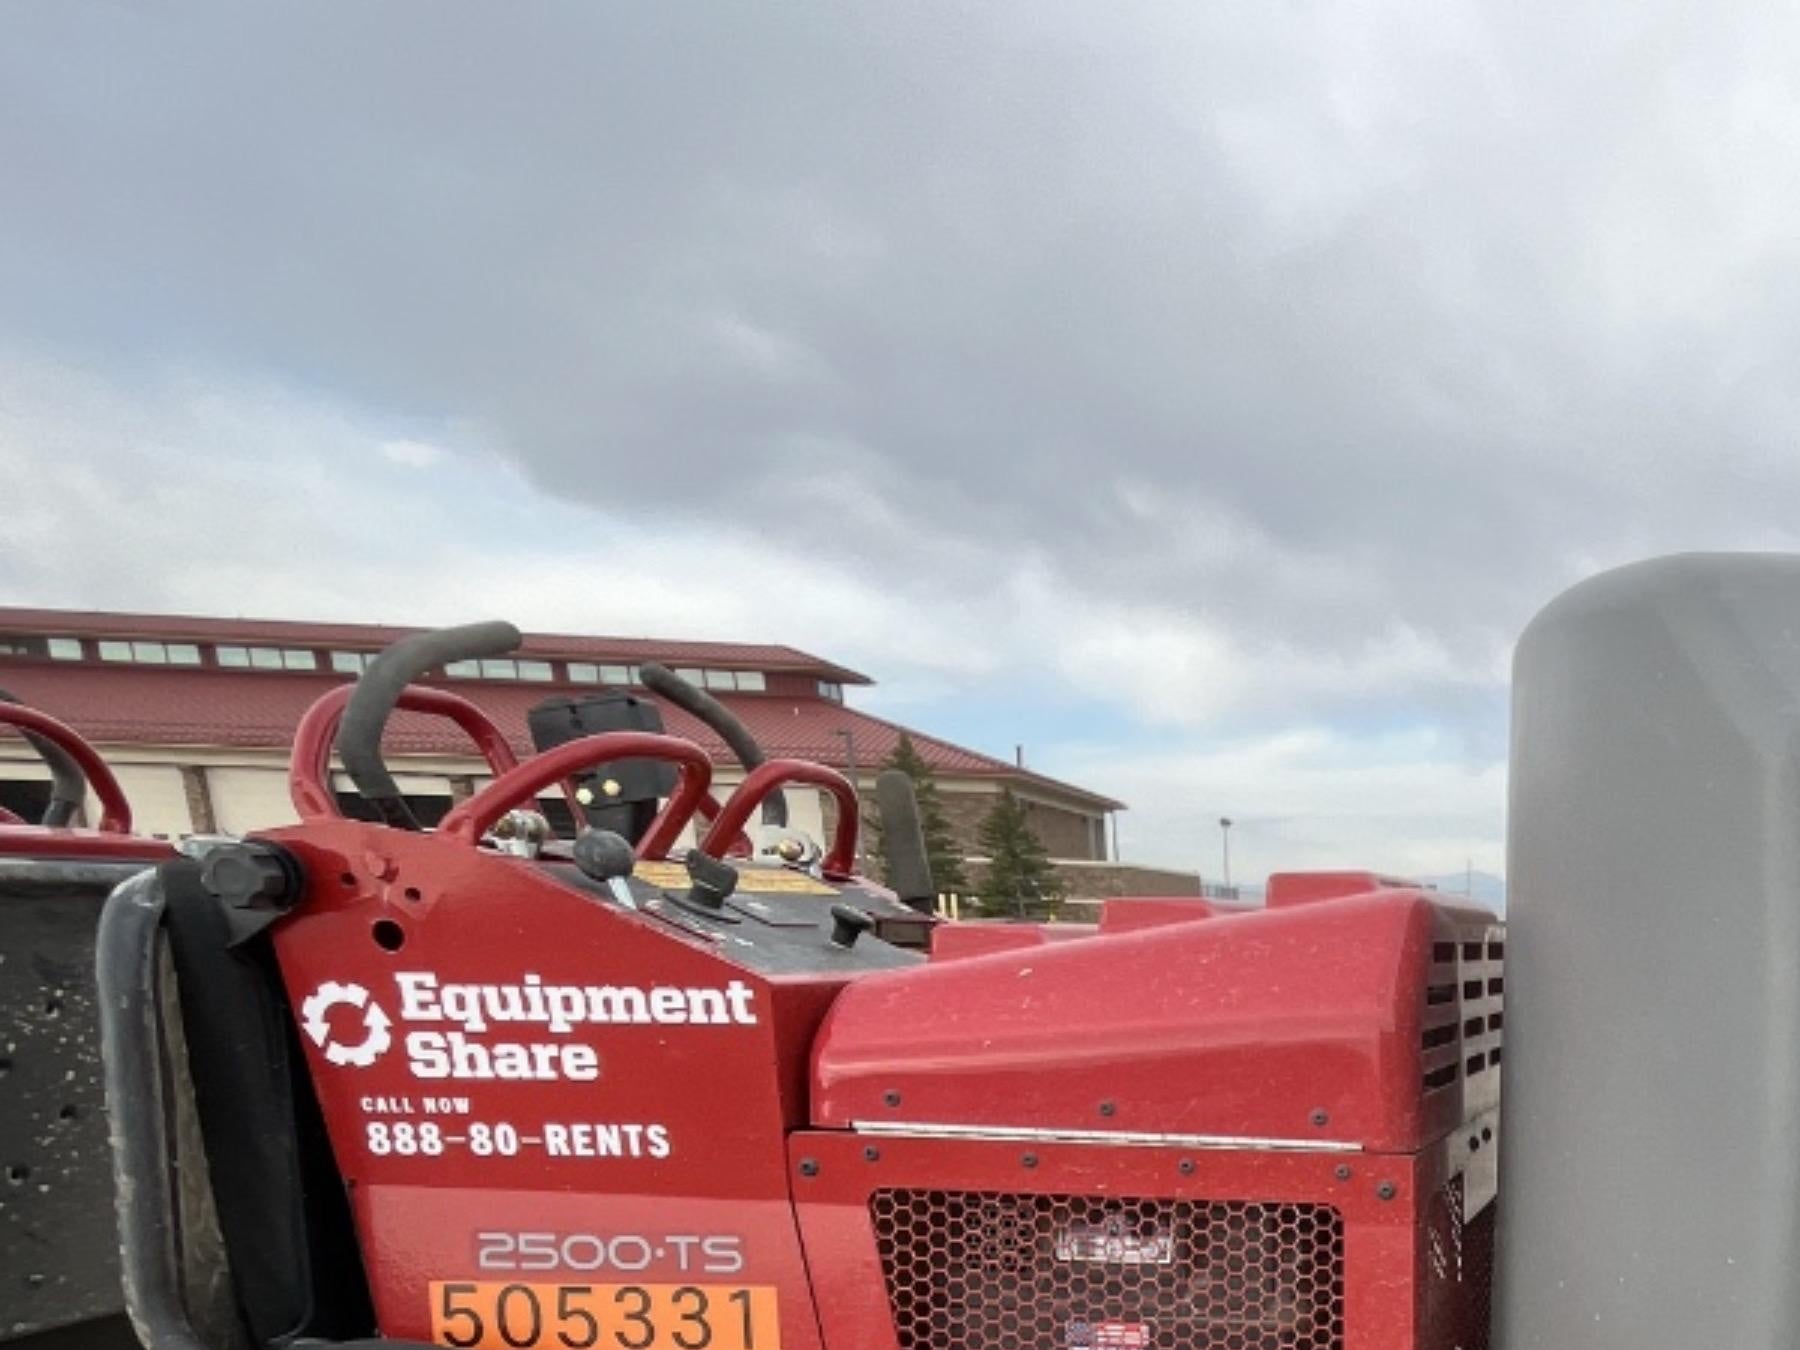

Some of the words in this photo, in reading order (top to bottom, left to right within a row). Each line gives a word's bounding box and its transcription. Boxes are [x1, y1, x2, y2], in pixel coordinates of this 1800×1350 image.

[395, 972, 757, 1032] Equipment
[406, 1031, 600, 1081] Share
[361, 1097, 414, 1113] CALL
[422, 1097, 470, 1114] NOW
[367, 1122, 671, 1158] 888-80-RENTS
